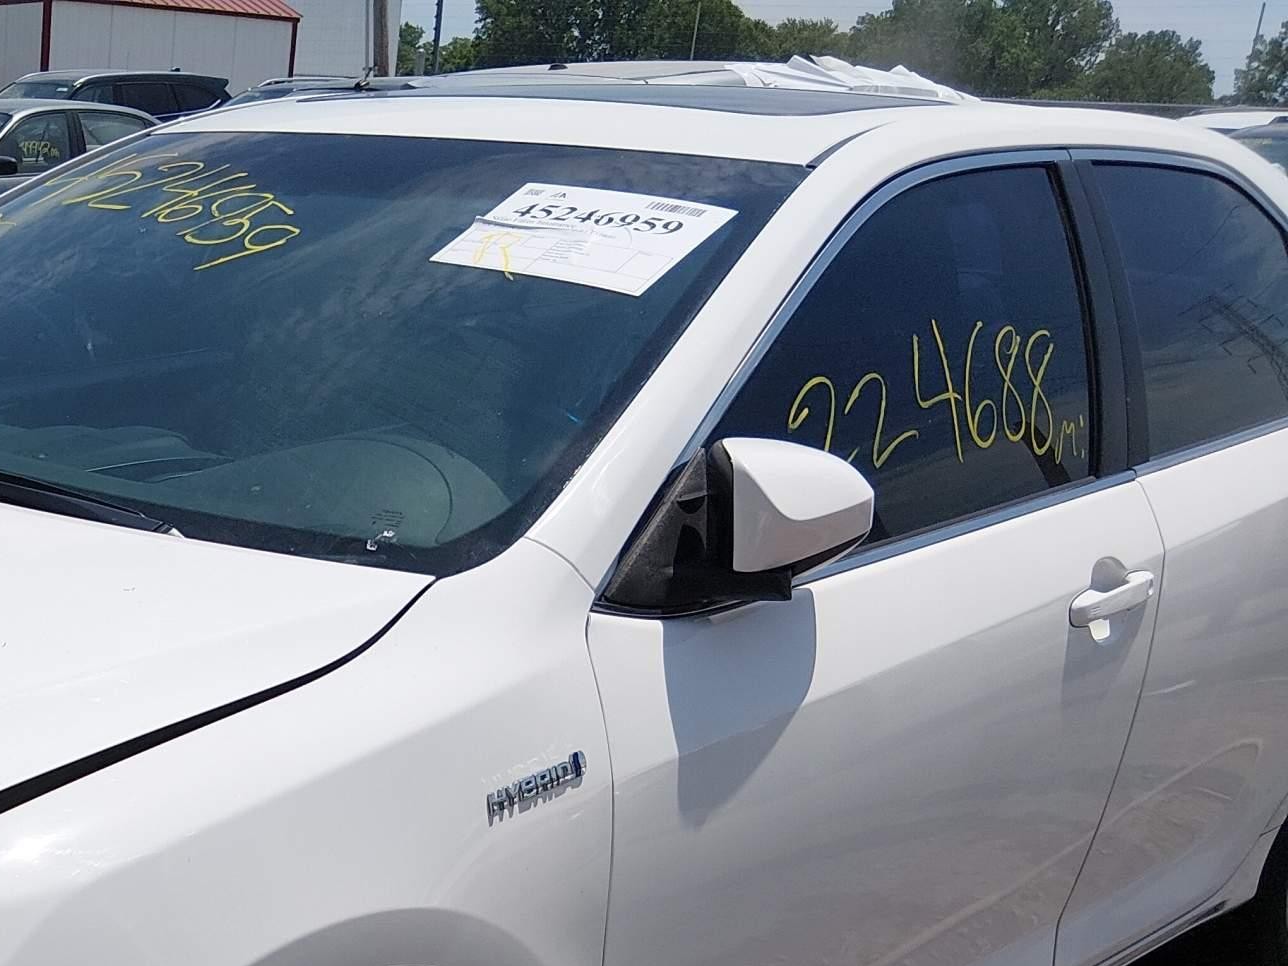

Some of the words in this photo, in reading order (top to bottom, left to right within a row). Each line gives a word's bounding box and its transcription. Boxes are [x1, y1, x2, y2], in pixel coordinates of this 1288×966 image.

[28, 152, 301, 271] 45246959
[511, 203, 684, 235] 45246959
[787, 318, 1054, 469] 224688
[486, 760, 574, 816] HYBRID
